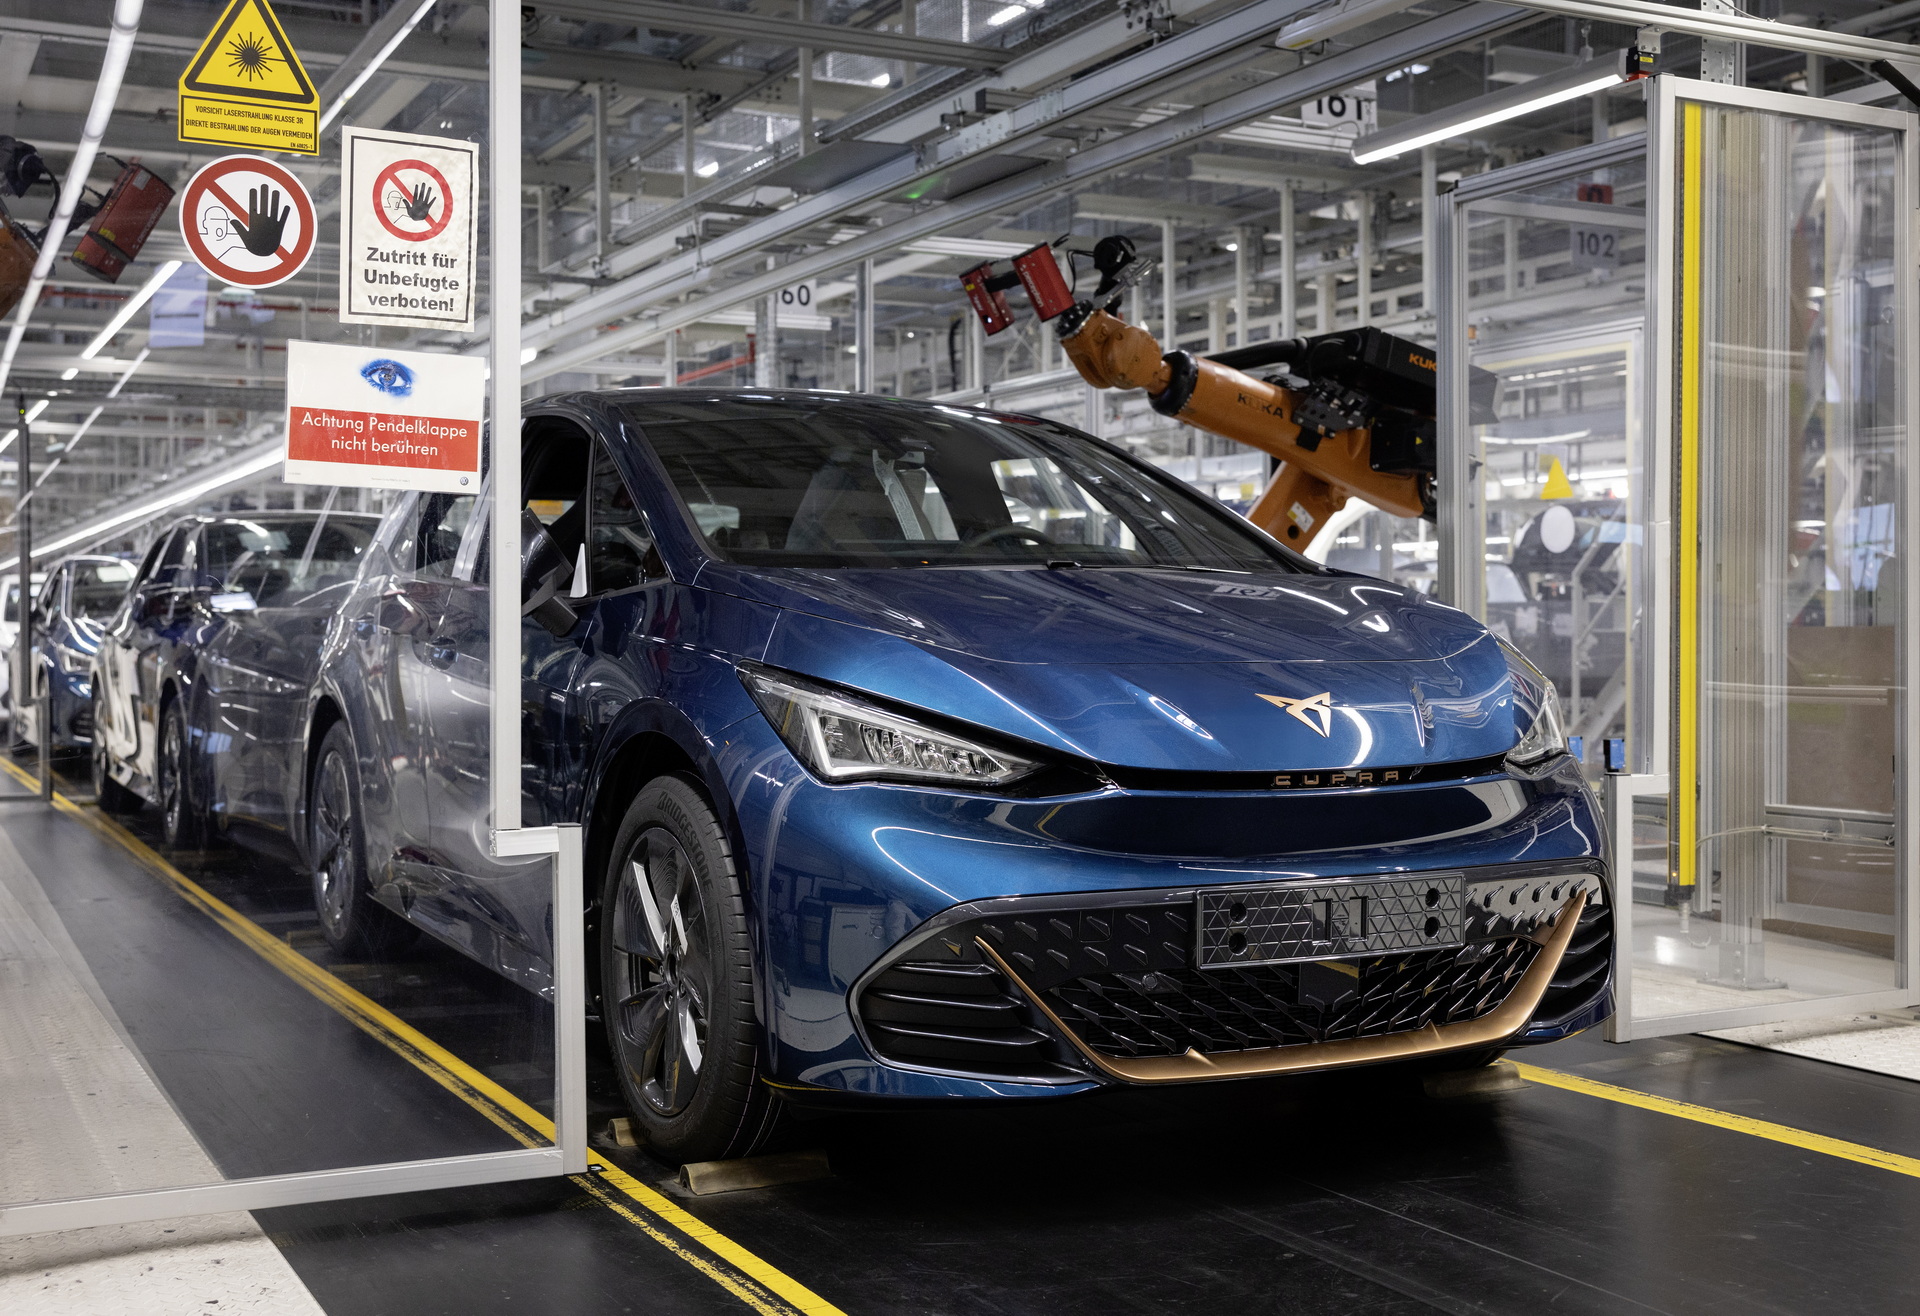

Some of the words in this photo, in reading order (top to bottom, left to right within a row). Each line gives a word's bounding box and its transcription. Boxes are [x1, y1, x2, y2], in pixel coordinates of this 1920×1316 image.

[195, 105, 222, 115] VORSICHT
[224, 109, 273, 121] LASERSTRAHLUNG
[274, 114, 295, 124] KLASSE
[185, 119, 208, 128] DIREKTE
[210, 121, 249, 133] BESTRAHLUNG
[250, 125, 261, 134] DER
[263, 128, 281, 136] AUGEN
[282, 129, 313, 139] VERMEIDEN
[1577, 231, 1615, 258] 102
[366, 246, 427, 266] Zutritt
[432, 252, 457, 268] für
[364, 268, 460, 293] Unbefugte
[367, 293, 454, 311] verboten!
[1408, 352, 1438, 373] KUK
[1237, 392, 1284, 420] KKA
[301, 411, 364, 432] Achtung
[369, 416, 468, 440] Pendelklappe
[331, 436, 367, 451] nicht
[371, 437, 438, 456] berühren
[1275, 770, 1399, 786] CUPRA
[657, 790, 713, 892] BRIDGESTONE
